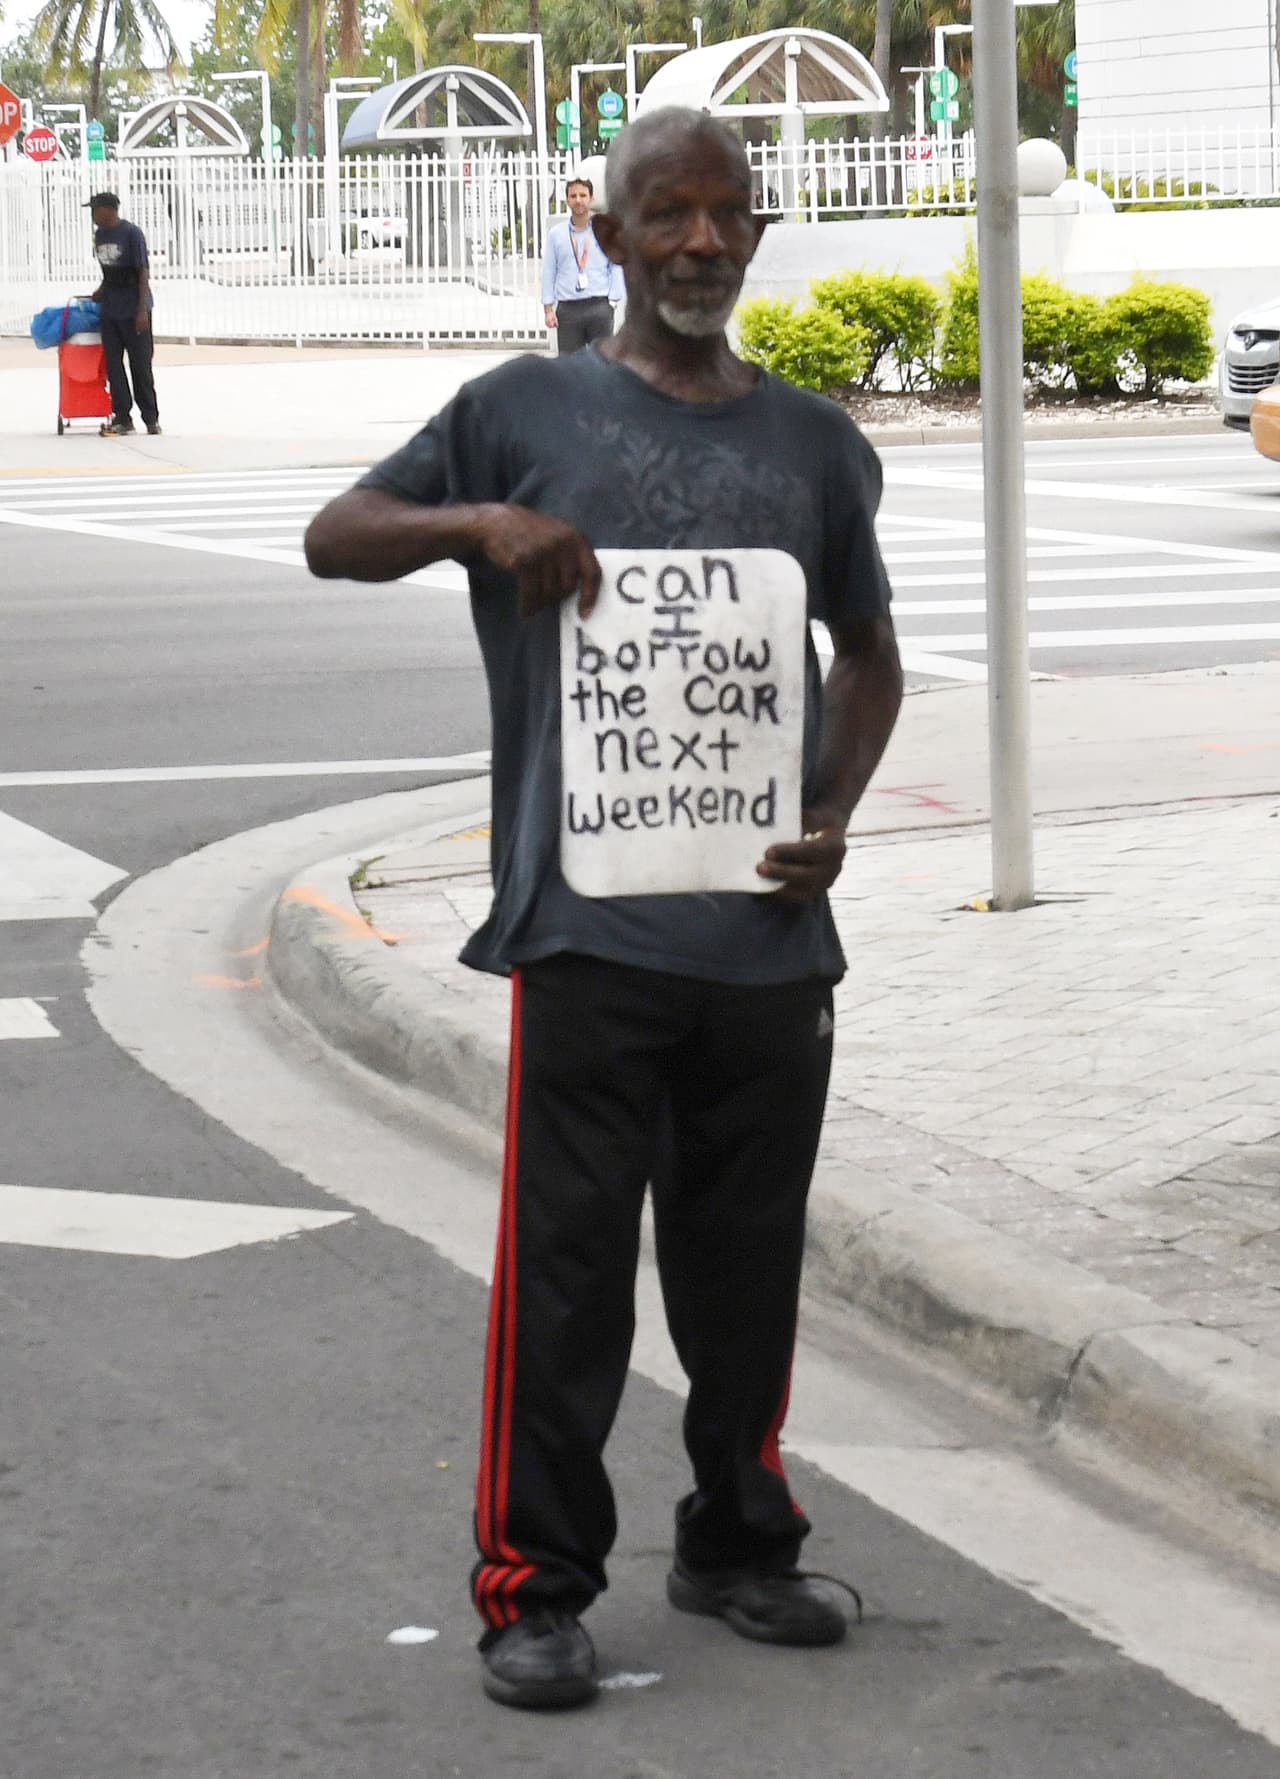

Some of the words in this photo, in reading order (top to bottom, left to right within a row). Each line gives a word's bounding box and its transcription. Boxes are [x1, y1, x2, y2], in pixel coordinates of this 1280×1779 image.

[26, 137, 57, 153] STOP
[616, 556, 739, 604] can
[650, 606, 702, 638] I
[575, 627, 771, 676] borrow
[569, 678, 647, 722] the
[595, 727, 739, 774] next
